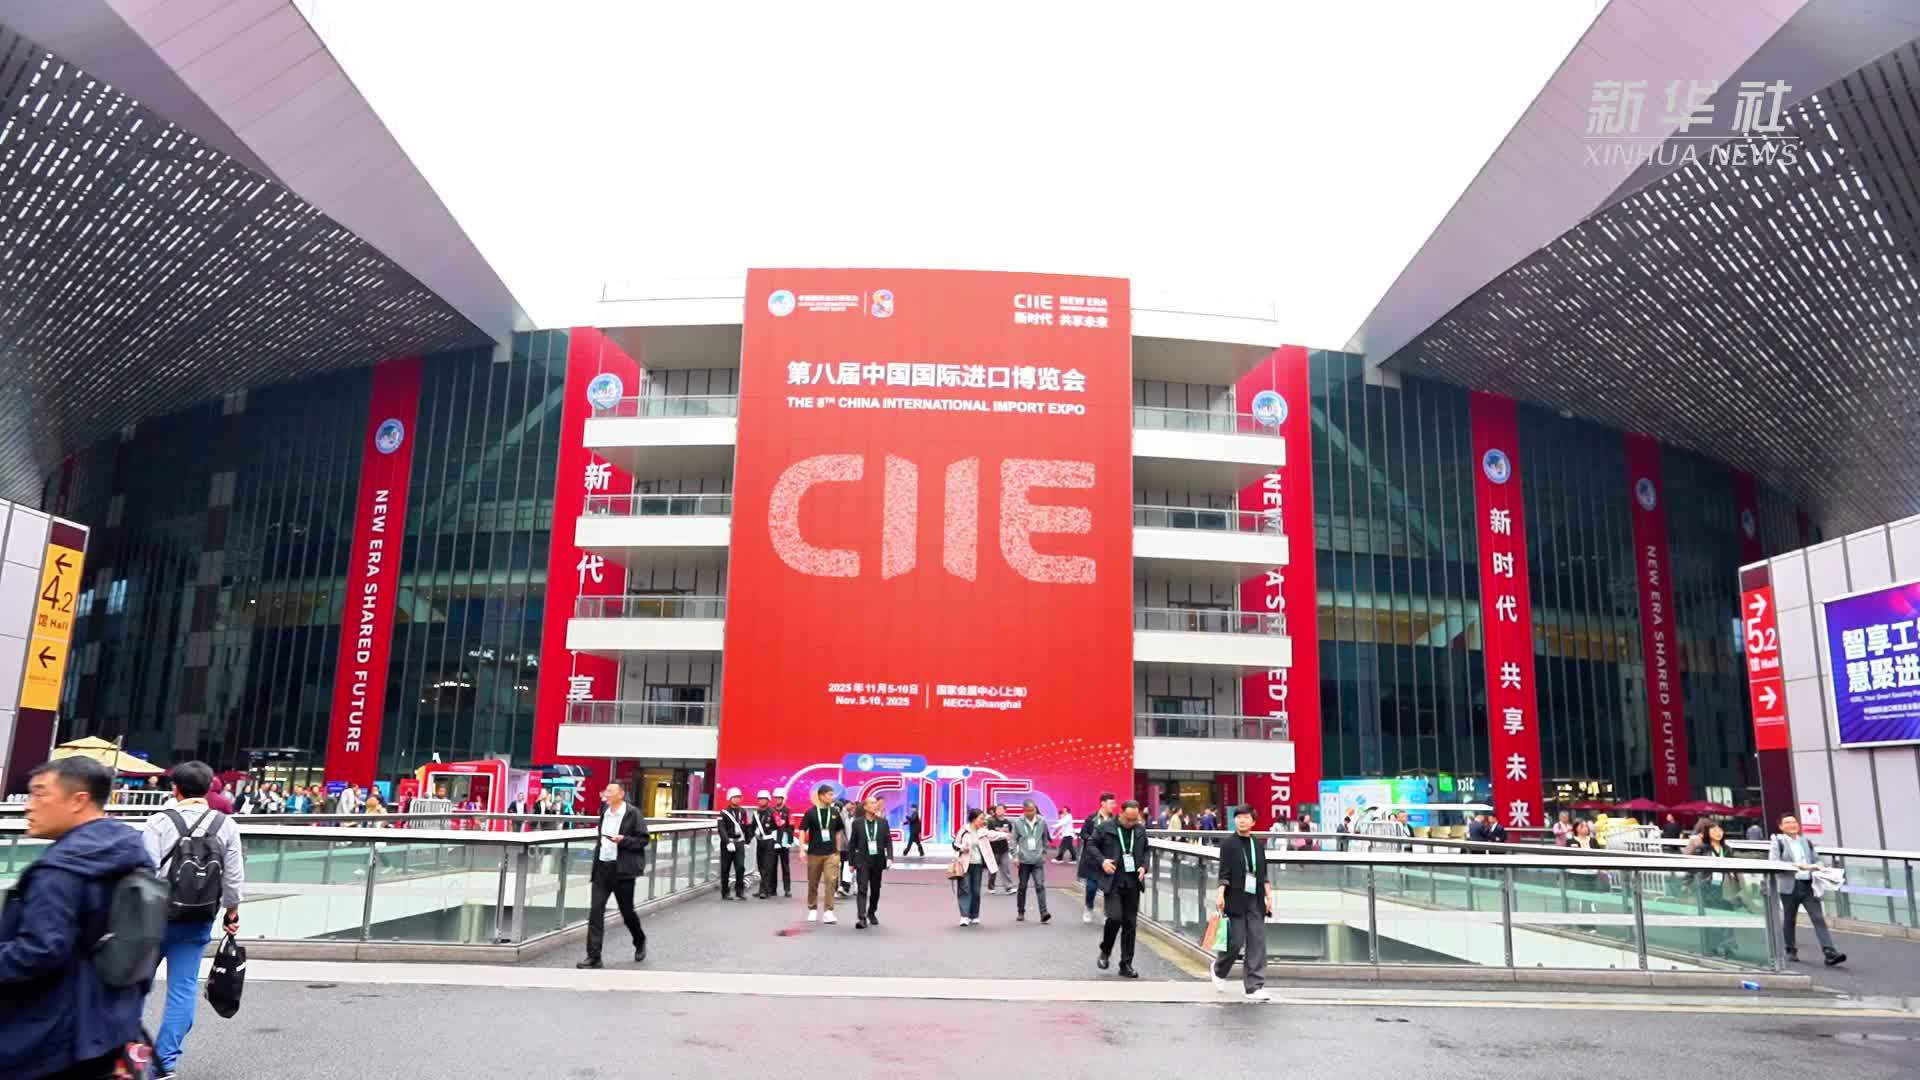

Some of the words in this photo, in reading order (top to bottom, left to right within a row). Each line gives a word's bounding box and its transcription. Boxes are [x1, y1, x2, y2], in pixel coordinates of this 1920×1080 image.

[1013, 293, 1053, 310] CIIE
[1059, 295, 1085, 306] NEW
[1086, 297, 1108, 307] ERA
[786, 360, 1086, 393] 第八届中国国际进口博览会
[786, 396, 814, 409] THE
[838, 397, 881, 410] CHINA
[882, 398, 991, 412] INTERNATIONAL
[993, 400, 1045, 414] IMPORT
[1047, 402, 1086, 416] EXPO
[371, 489, 390, 533] NEW
[768, 453, 1097, 584] CIIE
[366, 539, 384, 577] ERA
[1489, 507, 1519, 623] 新时代
[1647, 545, 1660, 586] NEW
[41, 575, 74, 614] 4.2
[1651, 591, 1664, 625] ERA
[50, 619, 69, 631] Hall
[356, 583, 378, 664] SHARED
[1842, 616, 1920, 661] 智享工
[1654, 631, 1671, 706] SHARED
[345, 670, 369, 753] FUTURE
[835, 695, 858, 705] Nov.
[886, 696, 911, 706] 2025
[1500, 661, 1531, 828] 共享未来
[1661, 711, 1678, 786] FUTURE
